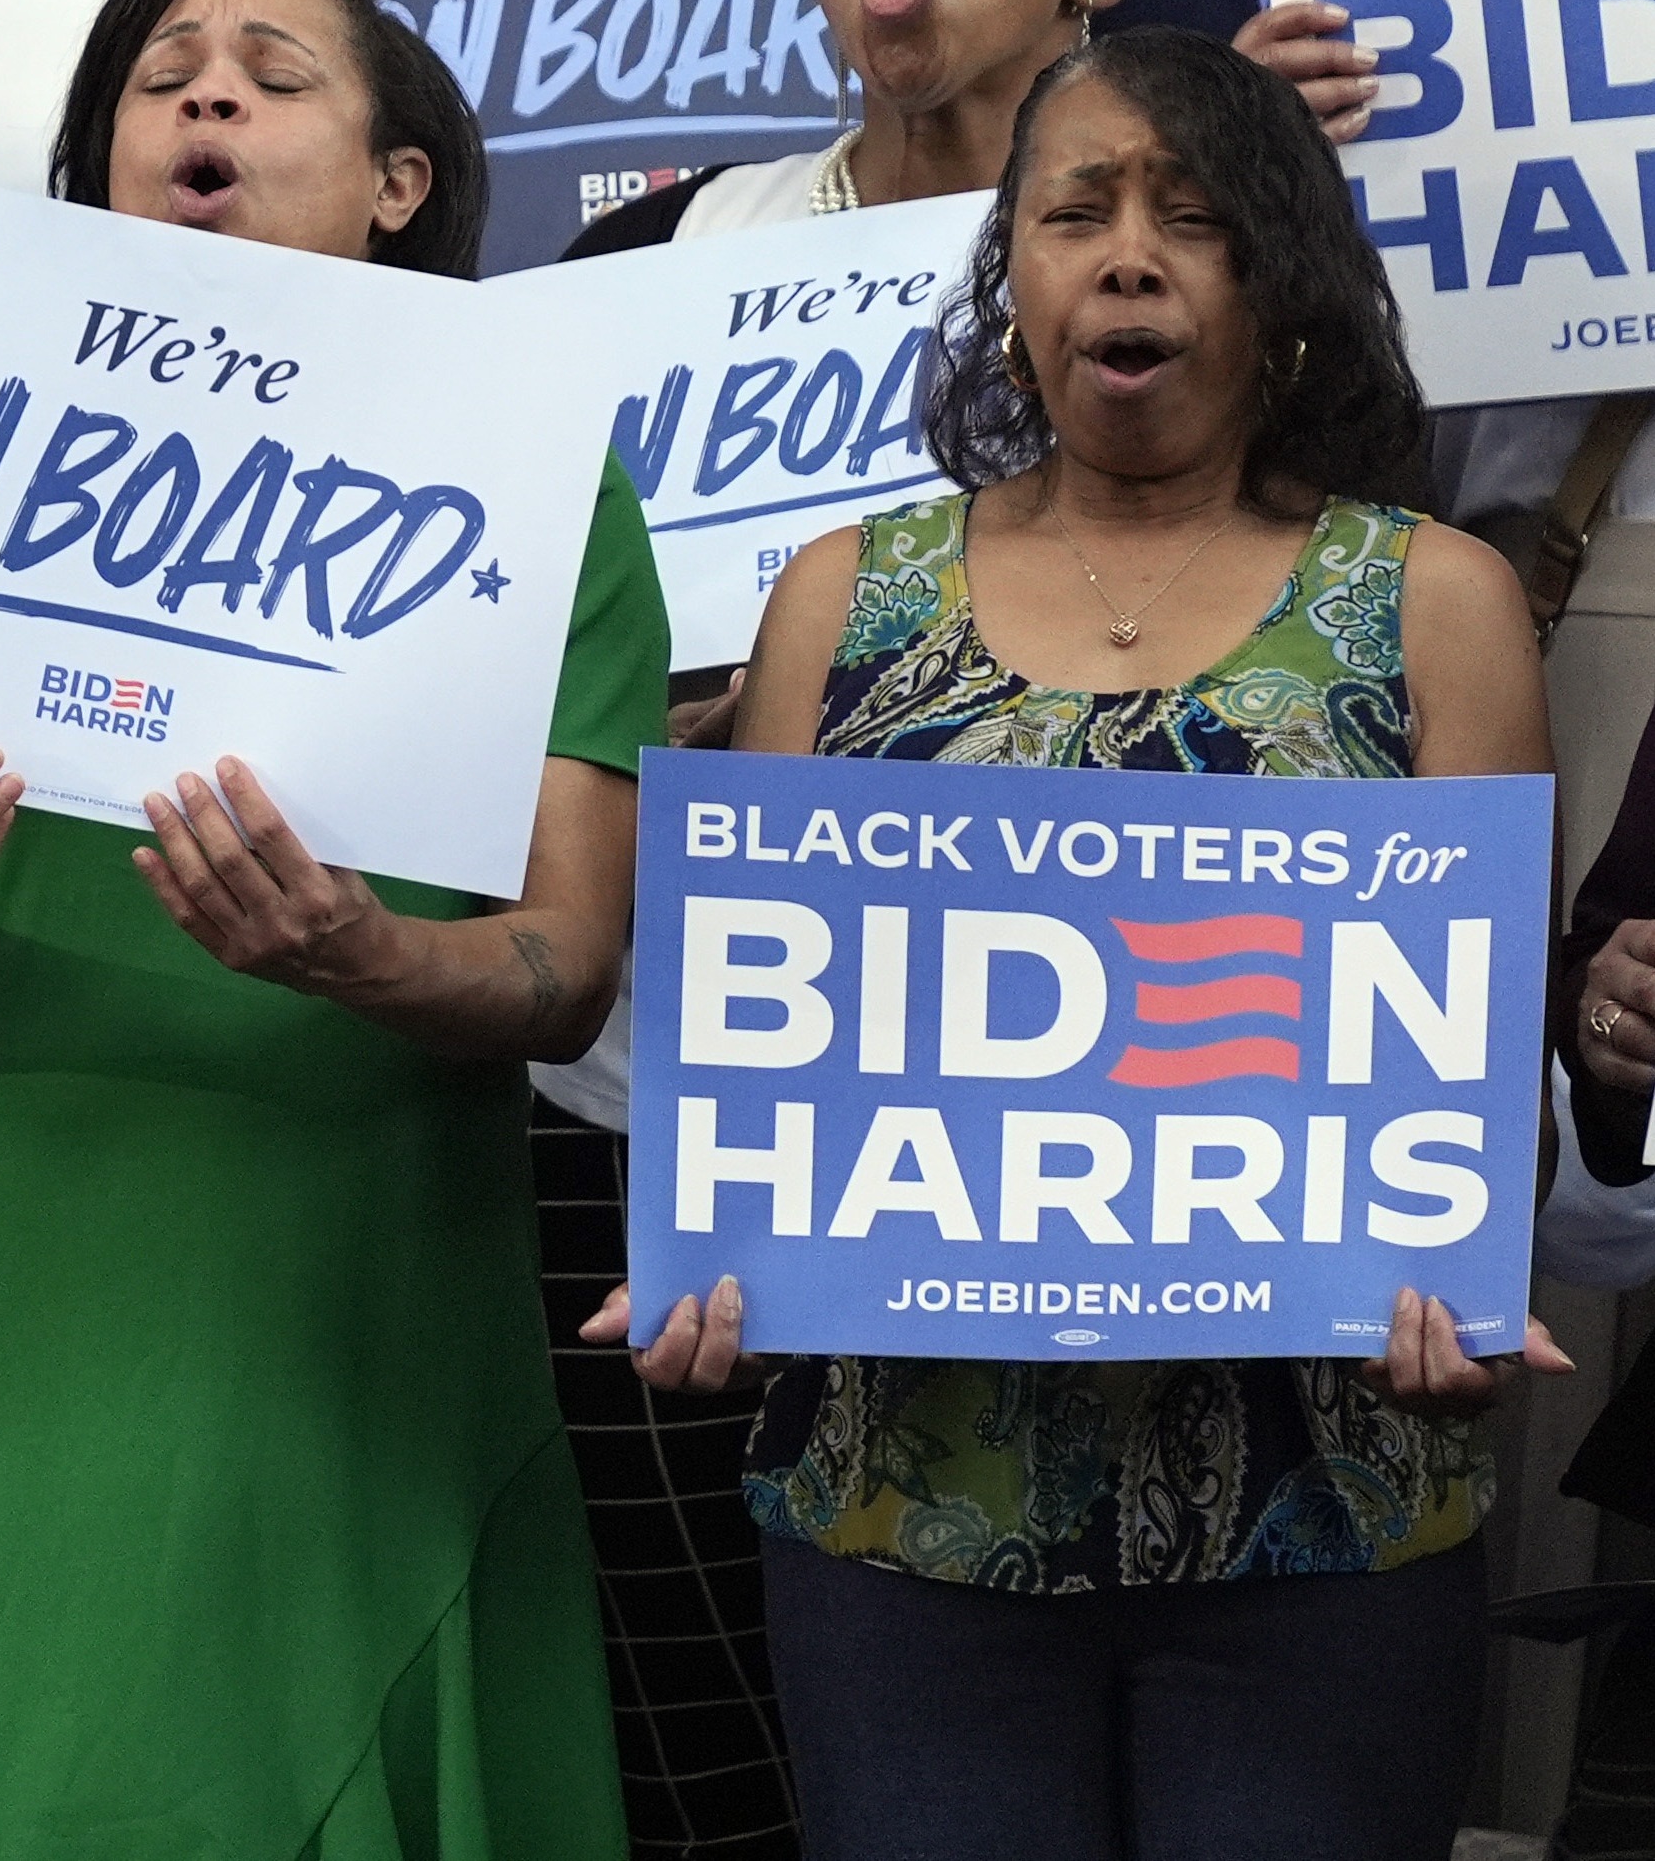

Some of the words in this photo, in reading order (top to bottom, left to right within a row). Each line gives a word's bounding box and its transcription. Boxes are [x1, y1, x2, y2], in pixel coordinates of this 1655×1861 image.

[728, 270, 936, 338] We're
[73, 299, 300, 404] We're
[693, 325, 936, 498] BOA
[35, 694, 168, 743] HARRIS
[40, 663, 174, 718] BIDEN
[107, 801, 144, 815] PRESIDE
[686, 801, 973, 871] BLACK
[997, 817, 1350, 885] VOTERS
[1356, 831, 1468, 902] for
[679, 894, 1492, 1086] BIDEN
[675, 1094, 1490, 1249] HARRIS
[887, 1279, 1272, 1316] JOEBIDEN.COM
[1335, 1322, 1361, 1333] PAID
